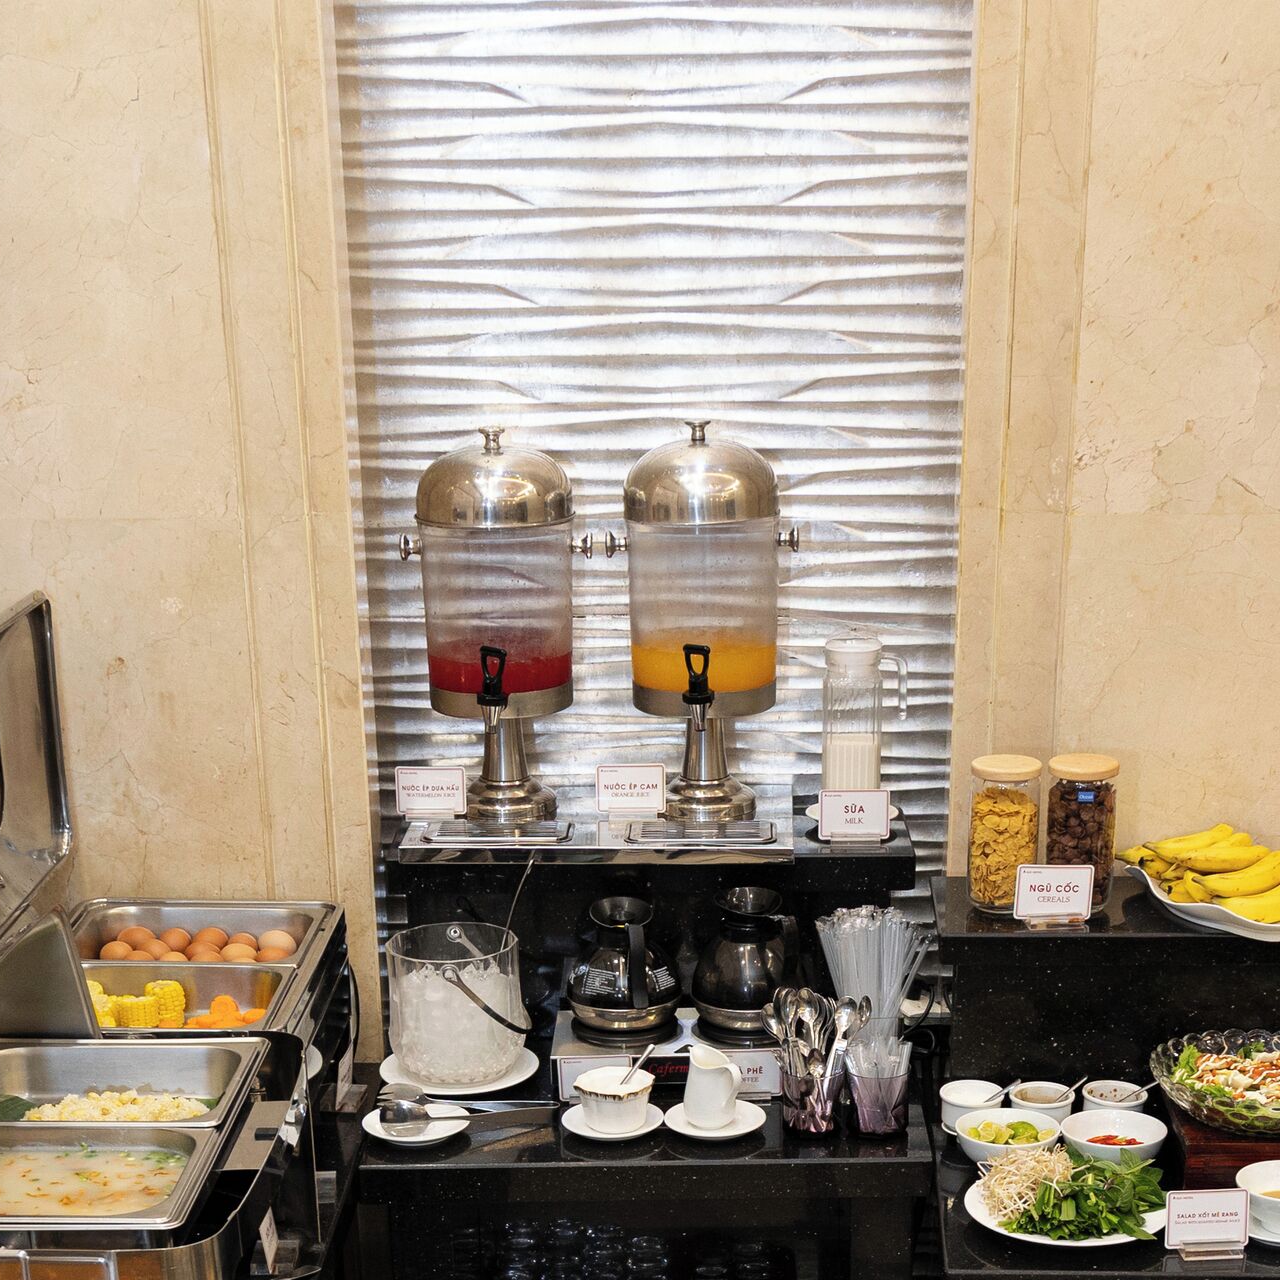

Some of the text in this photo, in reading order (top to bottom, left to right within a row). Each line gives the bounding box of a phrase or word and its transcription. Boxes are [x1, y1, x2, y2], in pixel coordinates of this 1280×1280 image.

[844, 803, 865, 813] SỮA
[1029, 881, 1080, 893] NGŨ CỐC
[1037, 896, 1071, 904] CEREALS
[647, 1062, 689, 1077] Caferm
[747, 1066, 763, 1074] PHÊ
